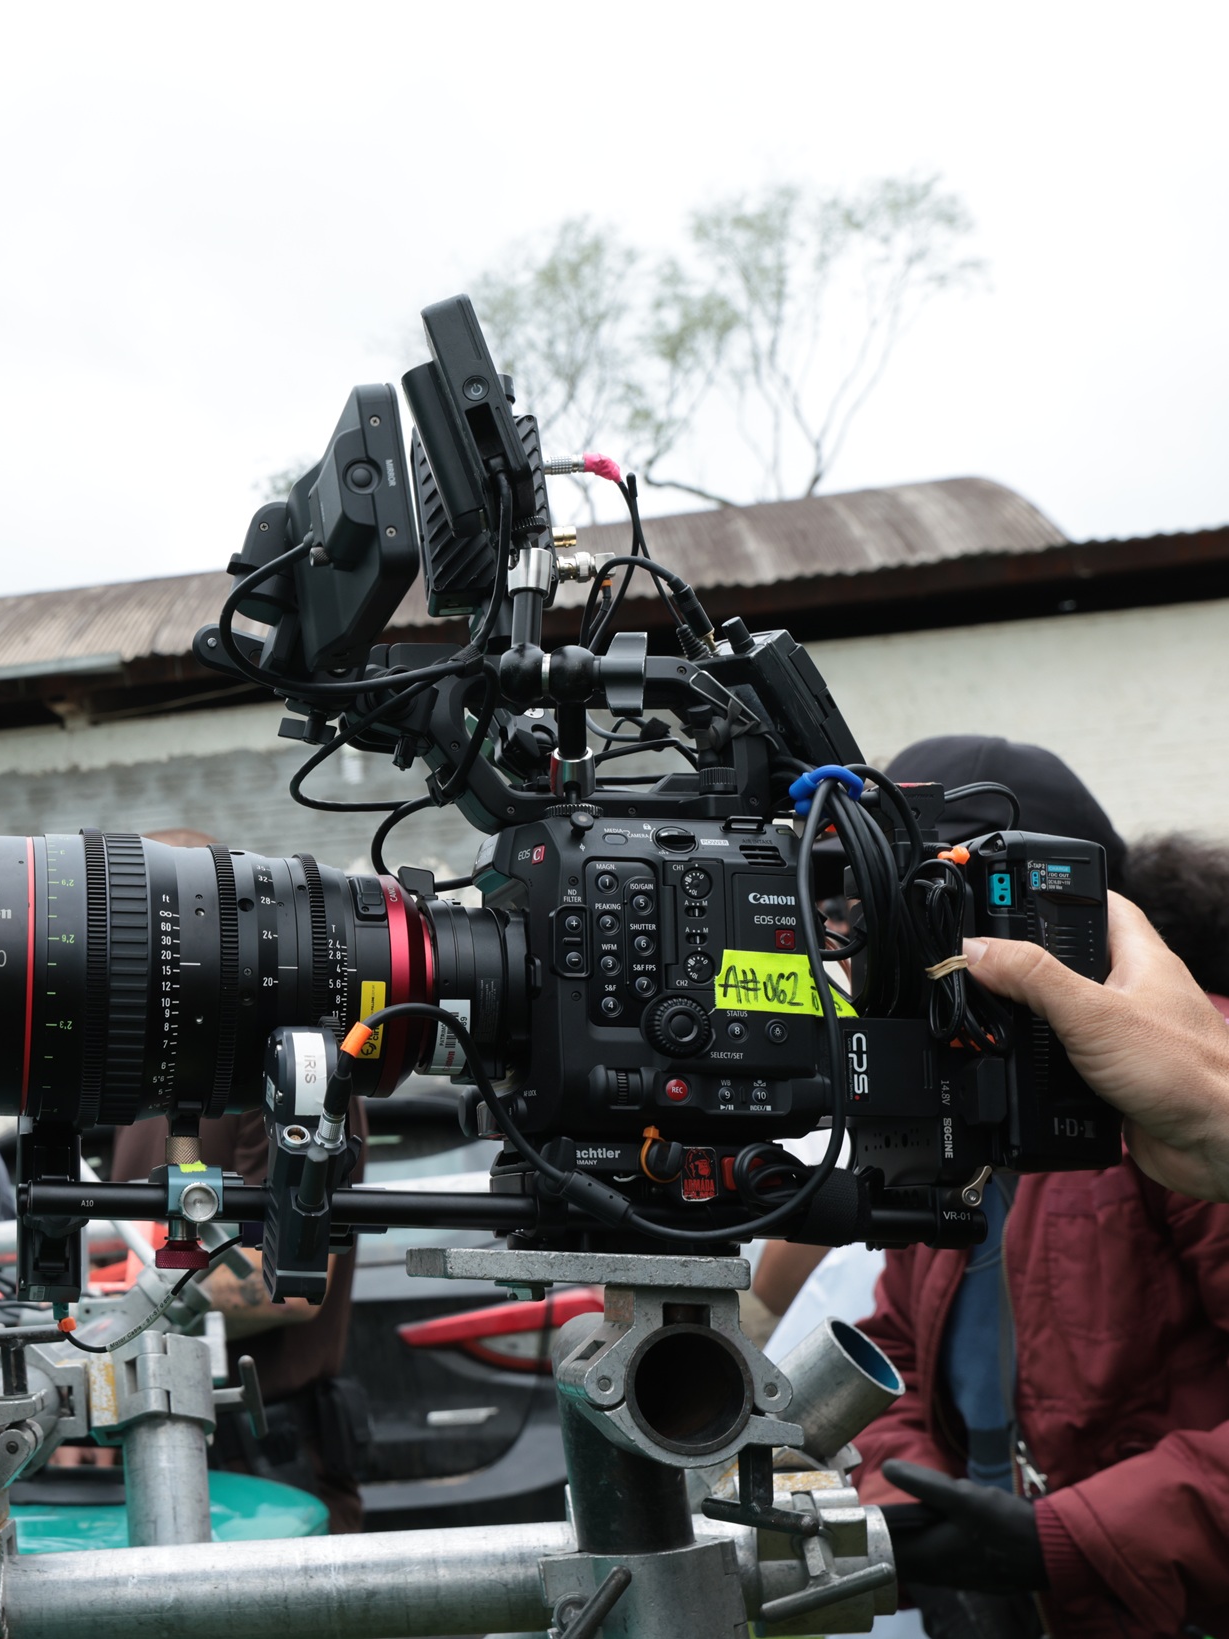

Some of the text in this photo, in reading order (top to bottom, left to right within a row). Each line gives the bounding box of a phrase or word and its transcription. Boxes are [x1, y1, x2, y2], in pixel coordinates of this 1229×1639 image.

[385, 459, 396, 487] MIRROR
[517, 848, 531, 861] EOS
[258, 875, 268, 883] 32
[567, 888, 577, 896] ND
[162, 894, 170, 903] ft
[260, 896, 271, 905] 28
[639, 899, 645, 907] 5
[748, 892, 796, 906] Canon
[605, 919, 612, 927] 2
[754, 915, 797, 926] EOS C400
[160, 922, 172, 932] 60
[331, 924, 336, 933] T
[262, 930, 273, 940] 24
[161, 935, 172, 945] 30
[328, 939, 340, 949] 2.4
[640, 939, 647, 948] 6
[161, 950, 172, 960] 20
[328, 950, 341, 960] 2.8
[336, 964, 341, 973] 4
[607, 960, 613, 968] 3
[162, 965, 172, 975] 15
[162, 981, 171, 991] 12
[263, 977, 273, 987] 20
[328, 979, 341, 988] 5.6
[641, 981, 648, 989] 7
[161, 998, 171, 1007] 10
[335, 995, 341, 1004] 8
[607, 1001, 614, 1009] 4
[164, 1008, 170, 1018] 9
[332, 1010, 339, 1018] 11
[163, 1022, 170, 1032] 8
[734, 1027, 741, 1035] 8
[163, 1040, 169, 1048] 7
[710, 1051, 744, 1060] SELECT/SET
[161, 1062, 167, 1070] 6
[304, 1055, 317, 1084] IRIS
[671, 1086, 683, 1094] REC
[724, 1090, 731, 1099] 9
[940, 1080, 951, 1106] 14.8V
[756, 1091, 767, 1100] 10
[575, 1147, 621, 1159] achtler
[81, 1199, 94, 1207] A10
[943, 1211, 971, 1221] VR-01
[110, 1336, 126, 1348] Motor
[127, 1325, 142, 1338] Cable
